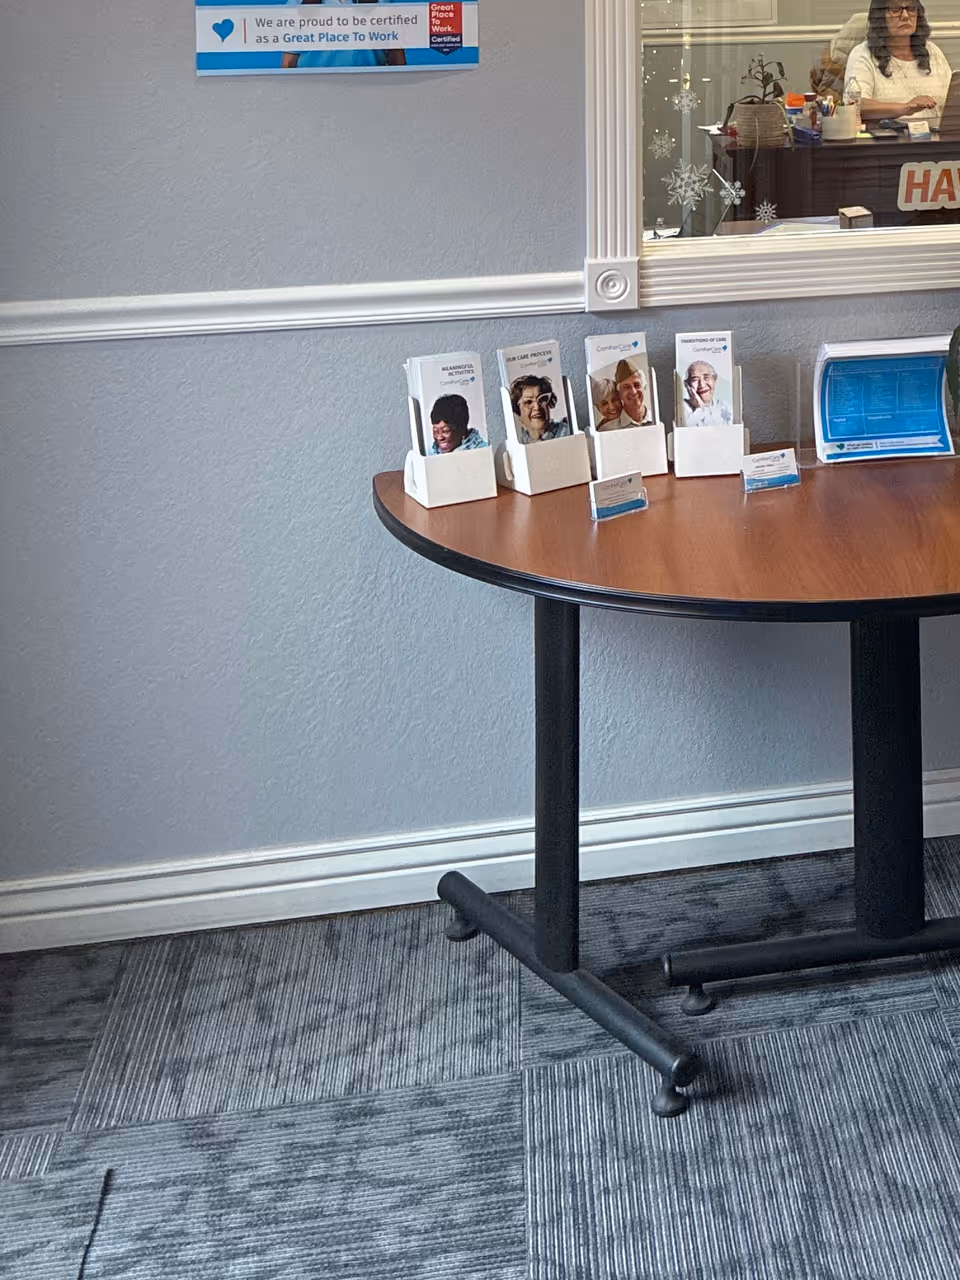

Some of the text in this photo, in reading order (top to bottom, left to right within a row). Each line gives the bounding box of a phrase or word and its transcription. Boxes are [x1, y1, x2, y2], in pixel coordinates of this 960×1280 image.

[430, 3, 454, 11] Great
[255, 15, 418, 30] We are proud to be certified
[255, 30, 398, 43] as a Great Place To Work
[517, 353, 529, 361] CARE
[530, 350, 552, 358] PROCESS
[441, 363, 474, 371] MEANINGFUL
